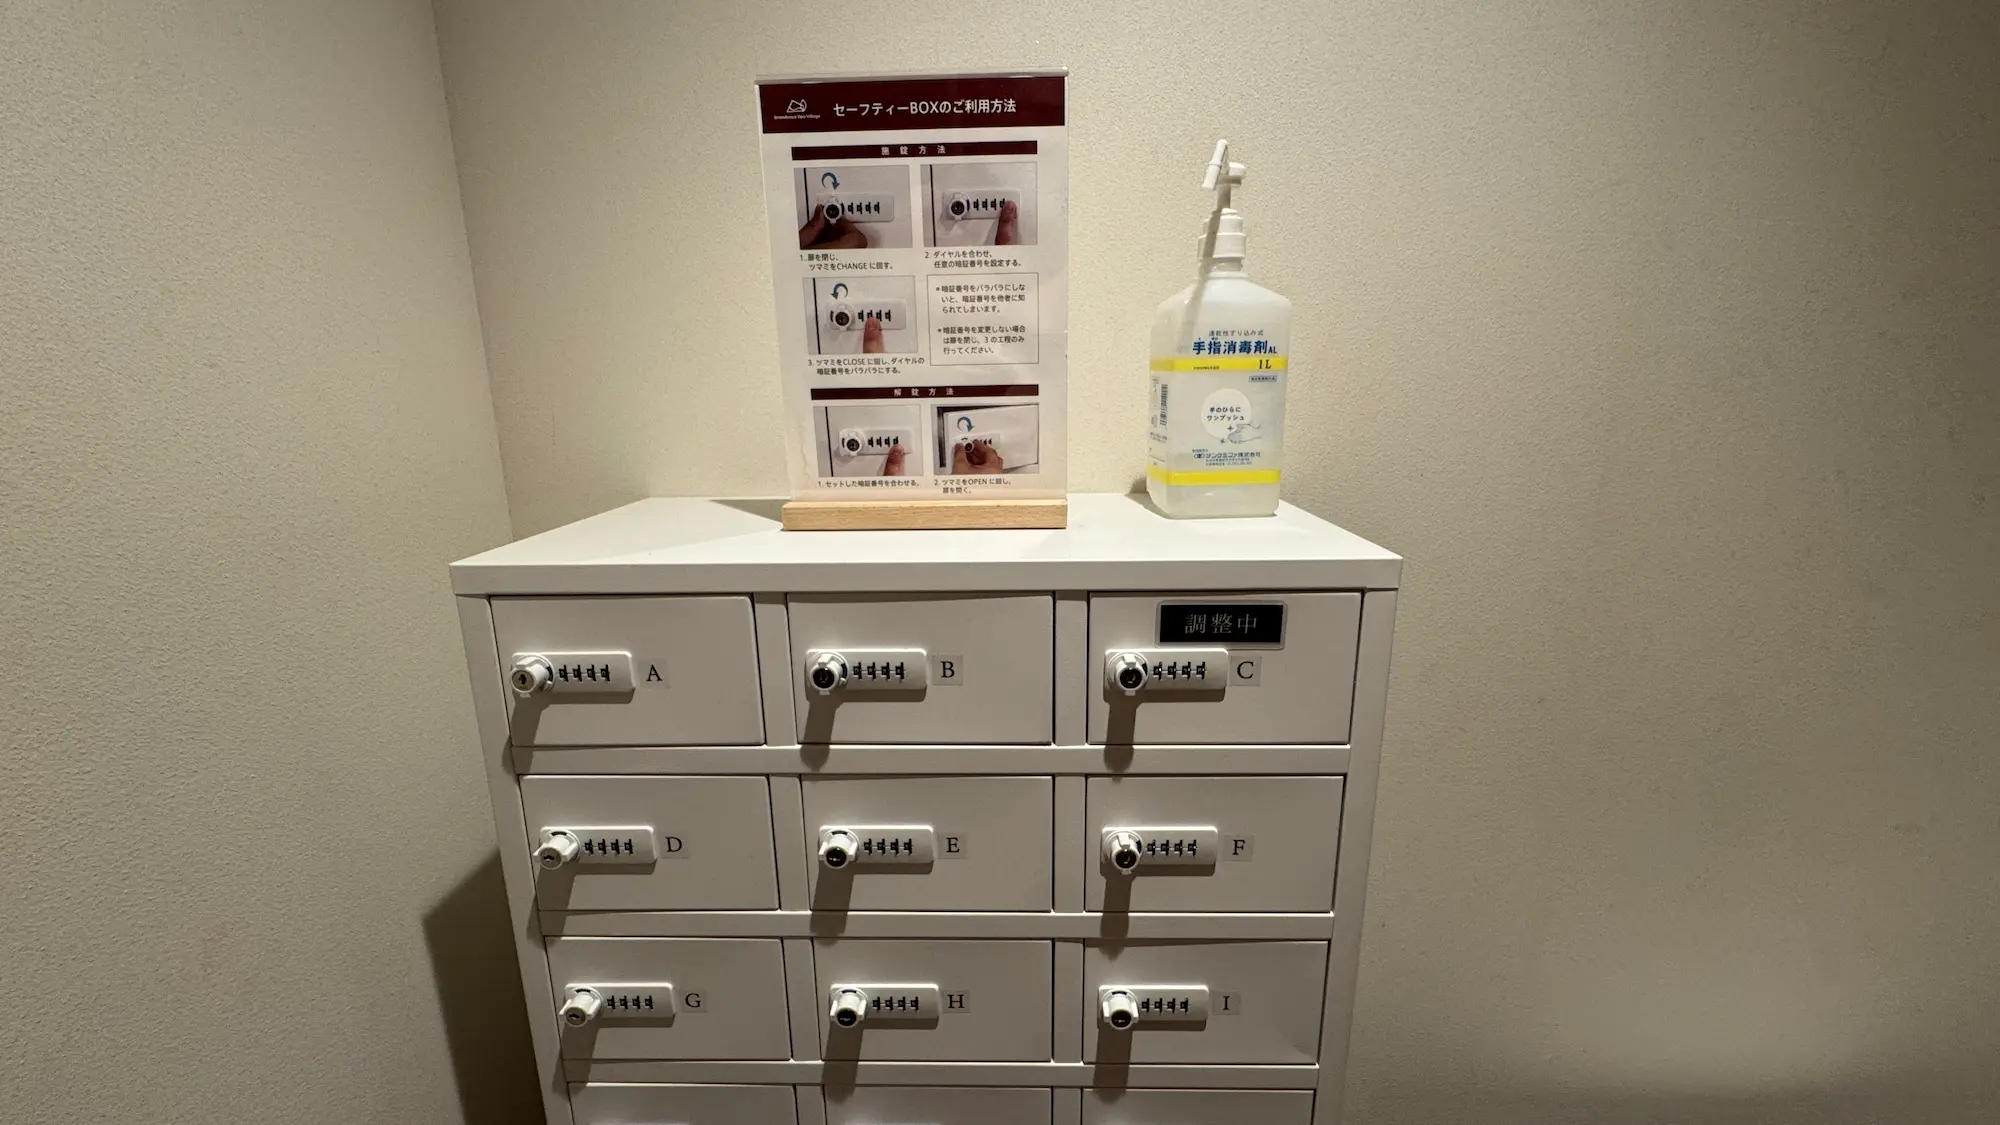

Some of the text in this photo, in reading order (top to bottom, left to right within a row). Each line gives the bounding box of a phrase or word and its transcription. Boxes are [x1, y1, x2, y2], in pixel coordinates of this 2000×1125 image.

[833, 98, 1017, 117] セーフティーBOXのご利用方法
[933, 259, 1021, 268] 任意の暗証番号を設定する。
[942, 305, 1000, 314] られてしまいます。
[943, 347, 994, 355] 行ってください。
[1184, 613, 1258, 634] 調整中
[645, 664, 663, 682] A
[940, 660, 955, 679] B
[1236, 660, 1255, 680] C
[665, 836, 683, 853] D
[946, 836, 960, 853] E
[1231, 839, 1246, 856] F
[685, 992, 701, 1008] G
[947, 994, 965, 1009] H
[1222, 995, 1230, 1011] I
